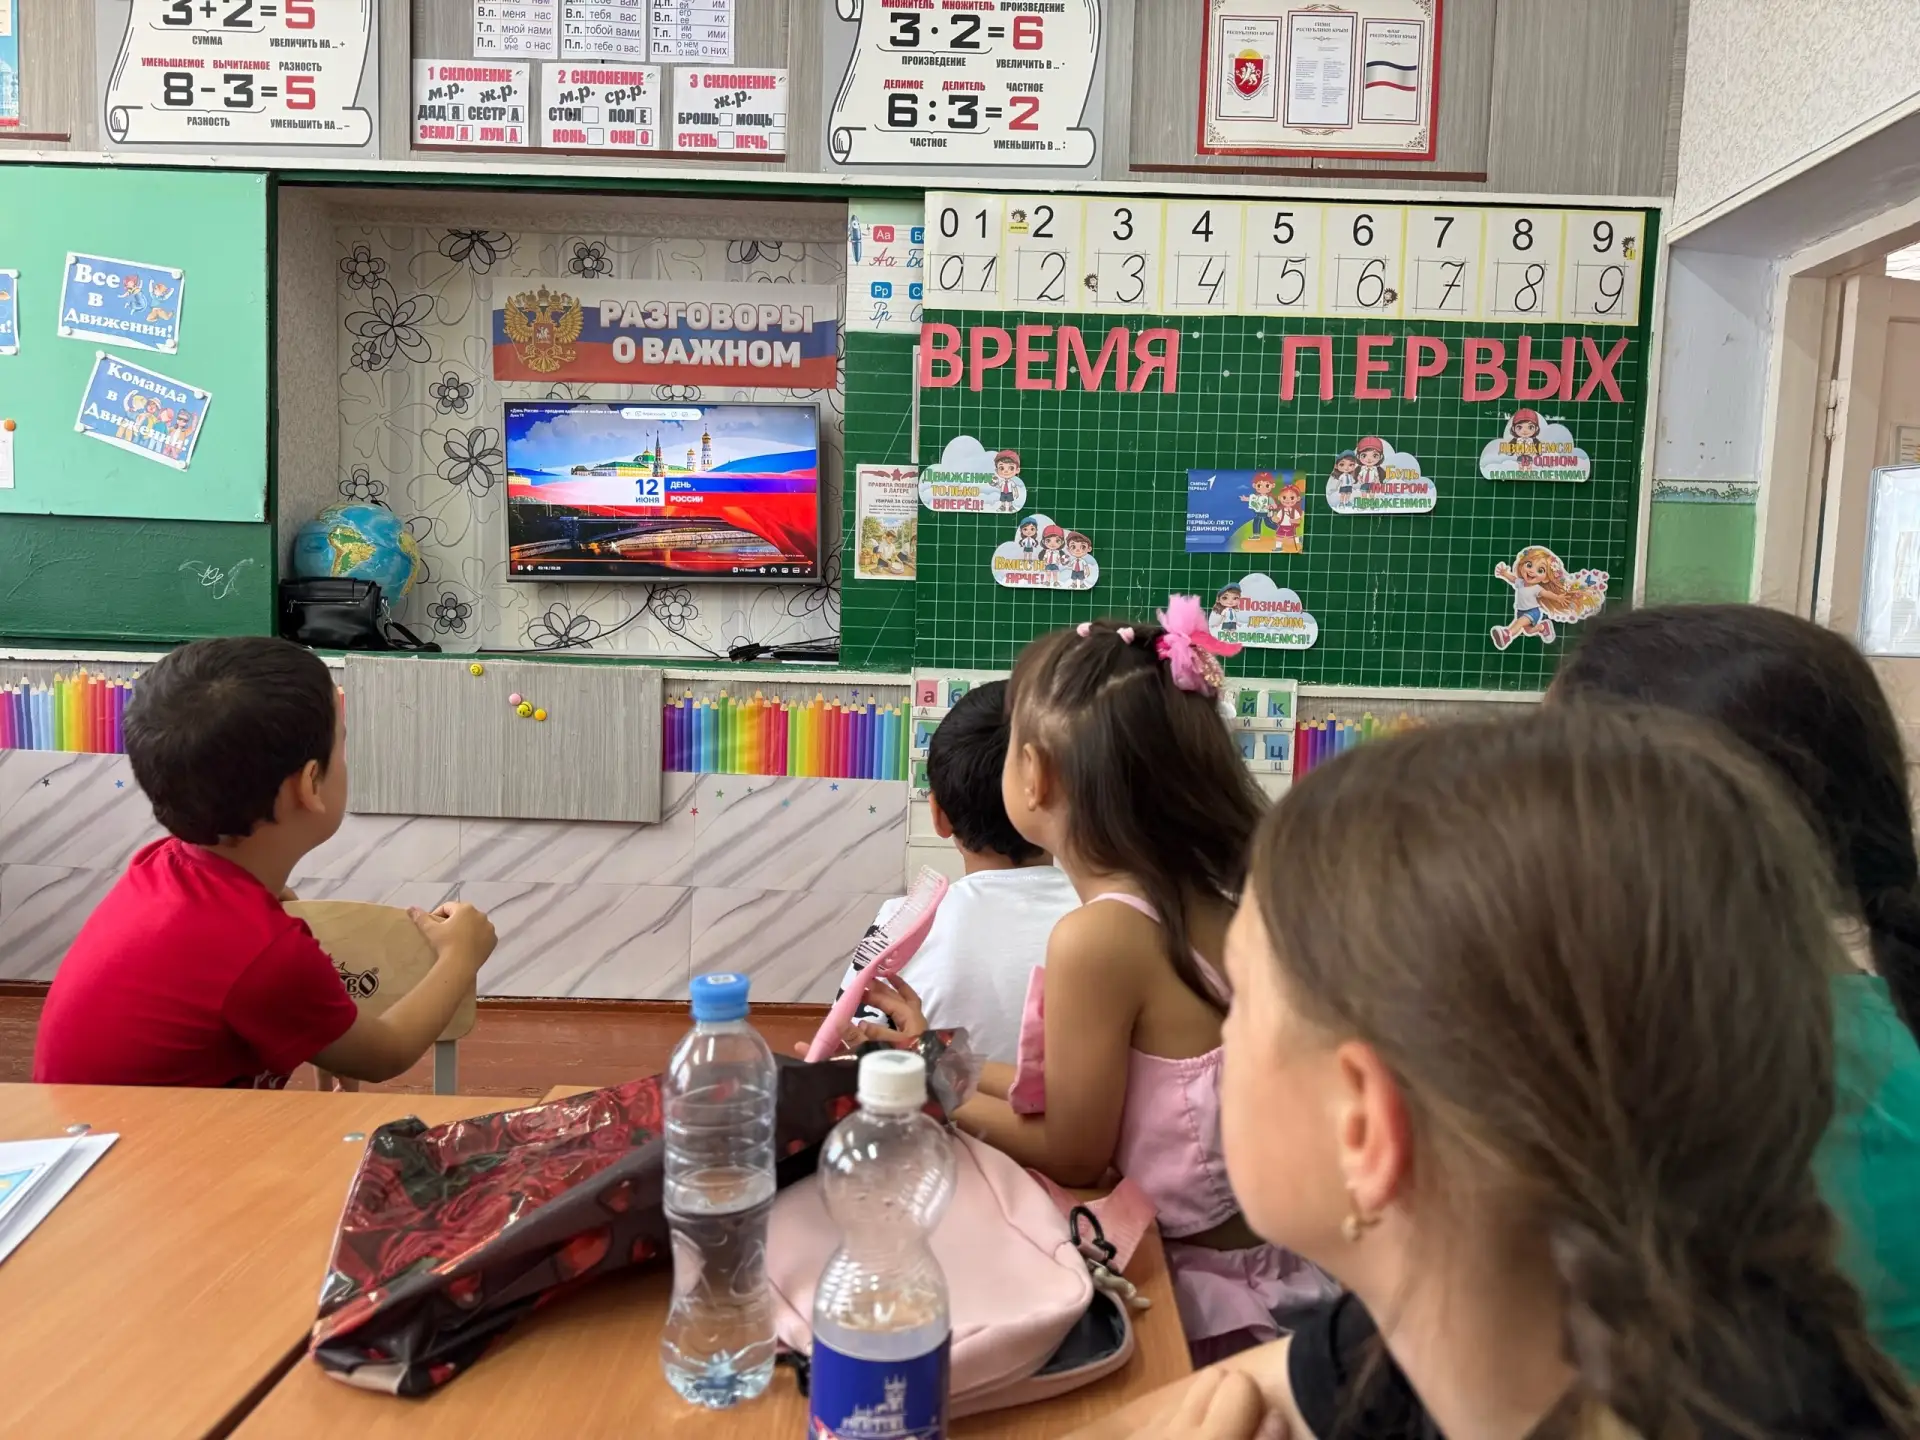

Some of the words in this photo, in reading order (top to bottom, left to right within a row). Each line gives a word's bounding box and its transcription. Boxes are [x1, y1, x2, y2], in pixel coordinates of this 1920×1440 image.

[478, 7, 497, 17] В.п.
[502, 10, 526, 18] меня
[534, 12, 552, 20] нас
[881, 0, 935, 10] МНОЖИТЕЛЬ
[942, 0, 995, 11] МНОЖИТЕЛЬ
[1000, 2, 1065, 13] ПРОИЗВЕДЕНИЕ
[565, 9, 584, 19] В.п.
[590, 9, 611, 20] тебя
[620, 13, 637, 22] вас
[654, 12, 673, 22] В.п.
[714, 14, 725, 23] их
[477, 22, 495, 32] Т.п.
[501, 24, 525, 34] мной
[528, 26, 552, 35] нами
[565, 24, 583, 34] Т.п.
[585, 24, 613, 35] тобой
[616, 28, 640, 37] вами
[653, 27, 671, 38] Т.п.
[708, 30, 726, 39] ими
[191, 35, 223, 47] СУММА
[269, 37, 318, 49] УВЕЛИЧИТЬ
[477, 37, 496, 48] П.п.
[534, 41, 551, 50] нас
[565, 39, 583, 49] П.п.
[594, 41, 613, 51] тебе
[624, 44, 639, 53] вас
[653, 42, 672, 53] П.п.
[711, 46, 727, 55] них
[141, 57, 205, 69] УМЕНЬШАЕМОЕ
[212, 59, 271, 71] ВЫЧИТАЕМОЕ
[278, 61, 323, 72] РАЗНОСТЬ
[901, 55, 967, 67] ПРОИЗВЕДЕНИЕ
[996, 58, 1045, 70] УВЕЛИЧИТЬ
[428, 66, 435, 80] 1
[439, 66, 512, 82] СКЛОНЕНИЕ
[558, 70, 566, 84] 2
[571, 70, 644, 85] СКЛОНЕНИЕ
[690, 74, 698, 88] 3
[703, 74, 776, 89] СКЛОНЕНИЕ
[883, 79, 924, 90] ДЕЛИМОЕ
[942, 80, 986, 91] ДЕЛИТЕЛЬ
[1006, 82, 1044, 93] ЧАСТНОЕ
[428, 82, 464, 101] м.р.
[479, 84, 518, 103] ж.р.
[559, 86, 595, 105] м.р.
[605, 85, 647, 105] ср.р.
[713, 91, 752, 109] ж.р.
[187, 115, 231, 127] РАЗНОСТЬ
[549, 107, 582, 122] СТОЛ
[678, 112, 719, 125] БРОШЬ
[736, 113, 773, 127] МОЩЬ
[270, 118, 324, 130] УМЕНЬШИТЬ
[553, 129, 586, 143] КОНЬ
[678, 133, 717, 148] СТЕПЬ
[736, 135, 768, 149] ПЕЧЬ
[910, 137, 948, 148] ЧАСТНОЕ
[993, 139, 1046, 150] УМЕНЬШИТЬ
[876, 230, 891, 240] Аа
[940, 207, 959, 238] 0
[975, 209, 987, 239] 1
[1033, 205, 1054, 239] 2
[1113, 207, 1134, 241] 3
[1192, 210, 1214, 242] 4
[1272, 212, 1294, 244] 5
[1352, 213, 1374, 246] 6
[1433, 217, 1455, 248] 7
[1512, 218, 1533, 251] 8
[1592, 220, 1614, 253] 9
[869, 247, 898, 267] Аа
[74, 262, 121, 288] Все
[1037, 252, 1066, 301] 2
[1116, 254, 1145, 303] 3
[1198, 257, 1225, 304] 4
[1276, 258, 1306, 305] 5
[1356, 258, 1385, 307] 6
[1438, 261, 1464, 309] 7
[1514, 263, 1545, 312] 8
[1594, 266, 1624, 313] 9
[874, 286, 889, 298] Рр
[88, 292, 104, 307] в
[600, 299, 813, 333] РАЗГОВОРЫ
[869, 301, 892, 329] Рр
[64, 308, 173, 338] Движении!
[612, 336, 636, 364] О
[642, 338, 801, 368] ВАЖНОМ
[920, 323, 1180, 394] ВРЕМЯ
[1280, 335, 1630, 403] ПЕРВЫХ
[107, 362, 187, 404] Команда
[106, 389, 118, 402] в
[84, 401, 189, 452] Движении!
[635, 478, 659, 495] 12
[670, 481, 691, 489] ДЕНЬ
[670, 495, 703, 503] РОССИИ
[1006, 573, 1044, 584] ЯРЧЕ!
[923, 690, 935, 703] а
